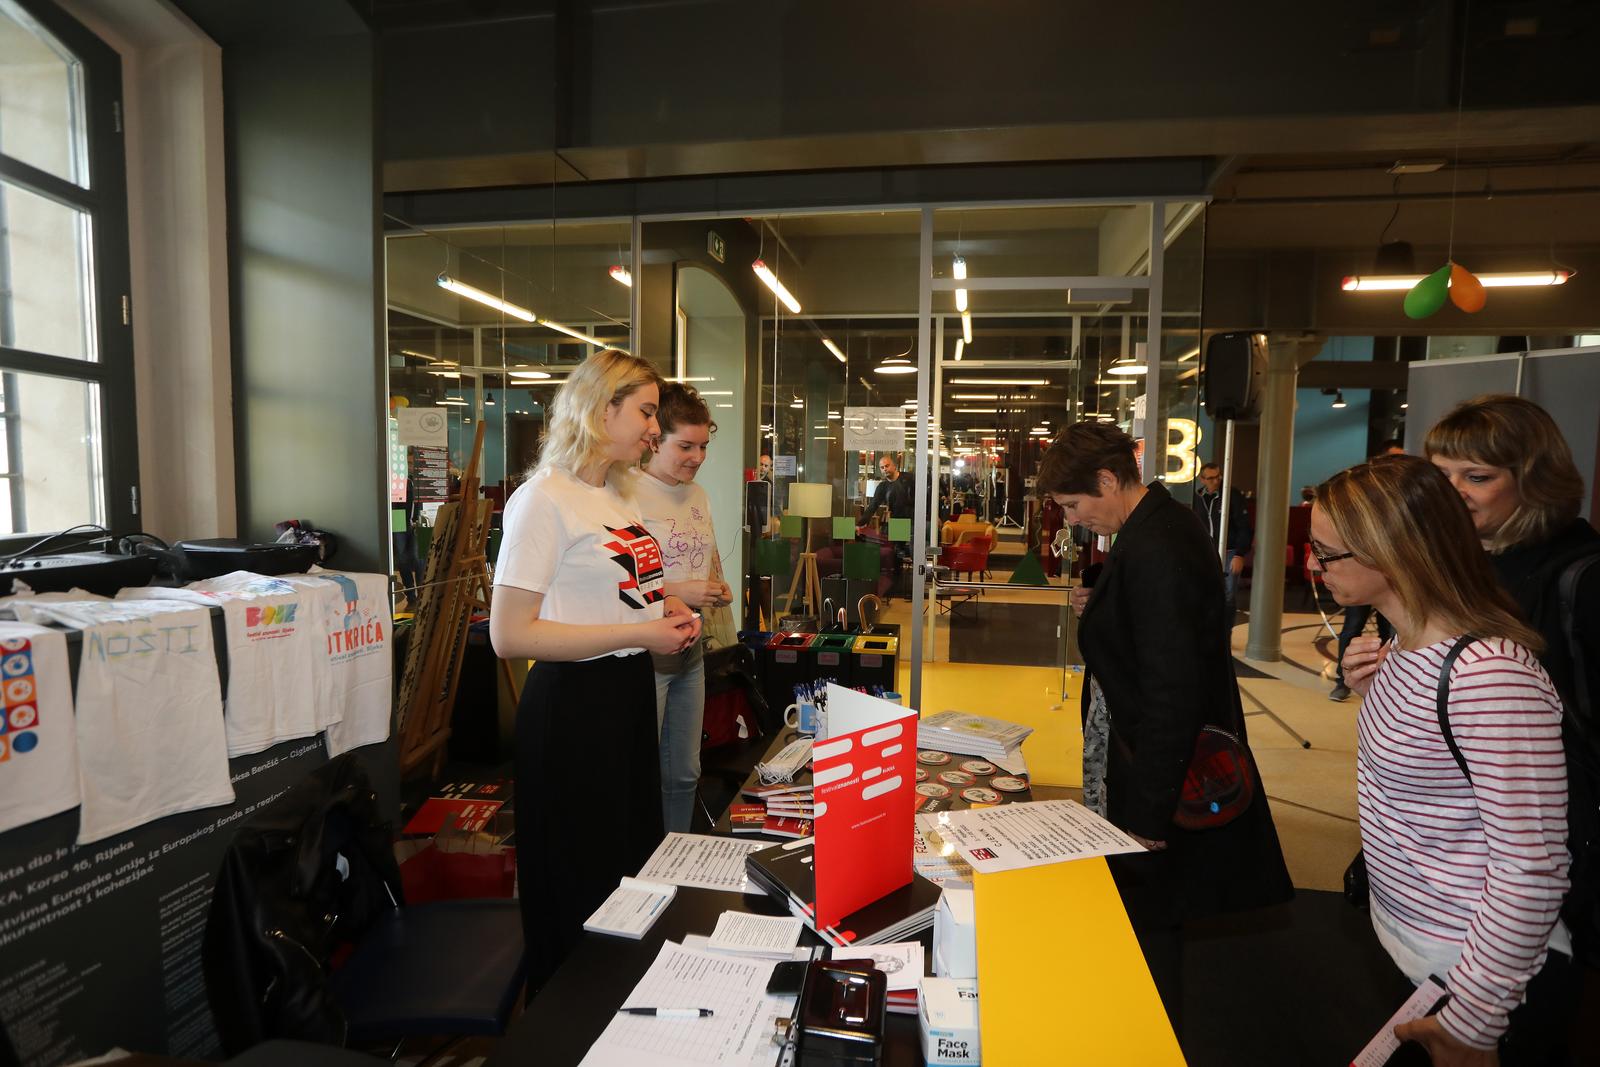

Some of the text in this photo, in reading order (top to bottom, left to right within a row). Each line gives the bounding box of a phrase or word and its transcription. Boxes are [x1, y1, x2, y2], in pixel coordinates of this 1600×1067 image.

[1165, 418, 1202, 483] B
[0, 866, 25, 882] kta
[28, 853, 53, 871] dio
[27, 869, 69, 895] Korzo
[95, 841, 135, 864] Rijeka
[52, 873, 112, 906] Europske
[115, 856, 145, 876] unije
[162, 823, 215, 853] Europskog
[217, 811, 243, 827] fonda
[244, 805, 256, 815] za
[937, 1048, 970, 1059] Mask
[938, 1038, 968, 1048] Face
